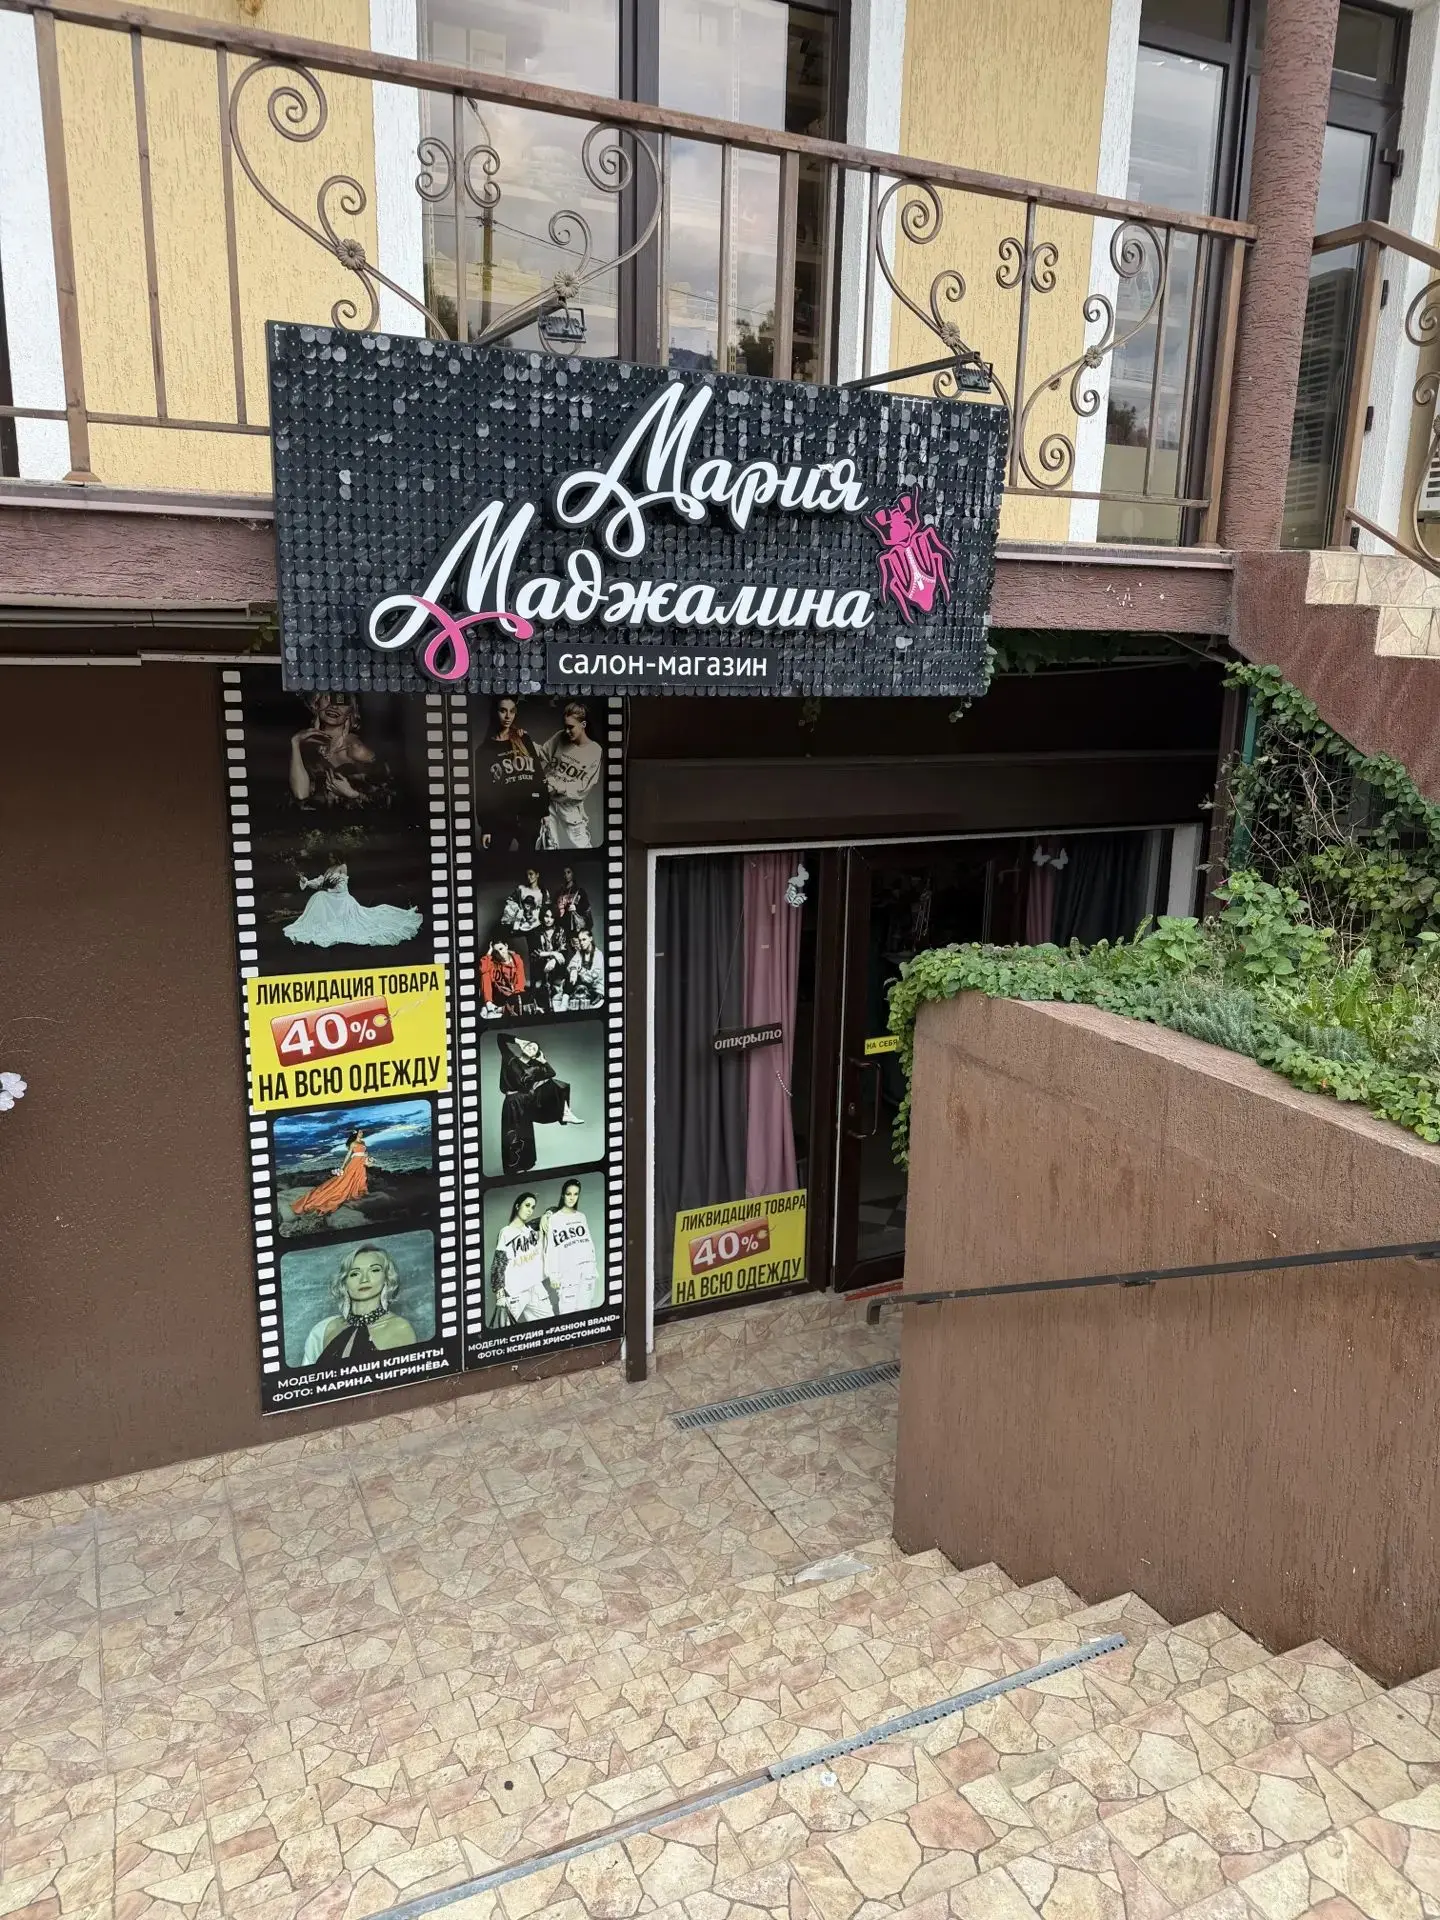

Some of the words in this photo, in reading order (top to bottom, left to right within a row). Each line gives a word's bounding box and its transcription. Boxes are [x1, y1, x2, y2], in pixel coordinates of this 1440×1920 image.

[556, 382, 870, 558] Мария
[369, 500, 875, 680] Маджалина
[558, 651, 768, 679] салон-магазин
[256, 976, 374, 1005] ЛИКВИДАЦИЯ
[379, 971, 440, 996] ТОВАРА
[280, 1012, 377, 1056] 40%
[714, 1028, 782, 1050] открыто
[866, 1041, 877, 1050] НА
[878, 1038, 898, 1049] СЕБЯ
[258, 1072, 289, 1102] НА
[295, 1067, 343, 1098] ВСЮ
[350, 1056, 441, 1093] ОДЕЖДУ
[681, 1203, 761, 1232] ЛИКВИДАЦИЯ
[764, 1195, 806, 1216] ТОВАРА
[693, 1231, 759, 1266] 40%
[676, 1280, 696, 1303] НА
[700, 1271, 733, 1297] ВСЮ
[737, 1257, 802, 1291] ОДЕЖДУ
[468, 1338, 508, 1351] МОДЕЛИ:
[509, 1330, 544, 1343] СТУДИЯ
[477, 1349, 506, 1360] ФОТО:
[507, 1342, 542, 1353] КСЕНИЯ
[543, 1325, 612, 1345] ХРИСОСТОМОВА
[272, 1388, 314, 1402] ФОТО:
[316, 1377, 373, 1394] МАРИНА
[375, 1359, 450, 1381] ЧИГРИНЁВА
[277, 1370, 337, 1389] МОДЕЛИ:
[340, 1361, 380, 1376] НАШИ
[383, 1348, 444, 1366] КЛИЕНТЫ
